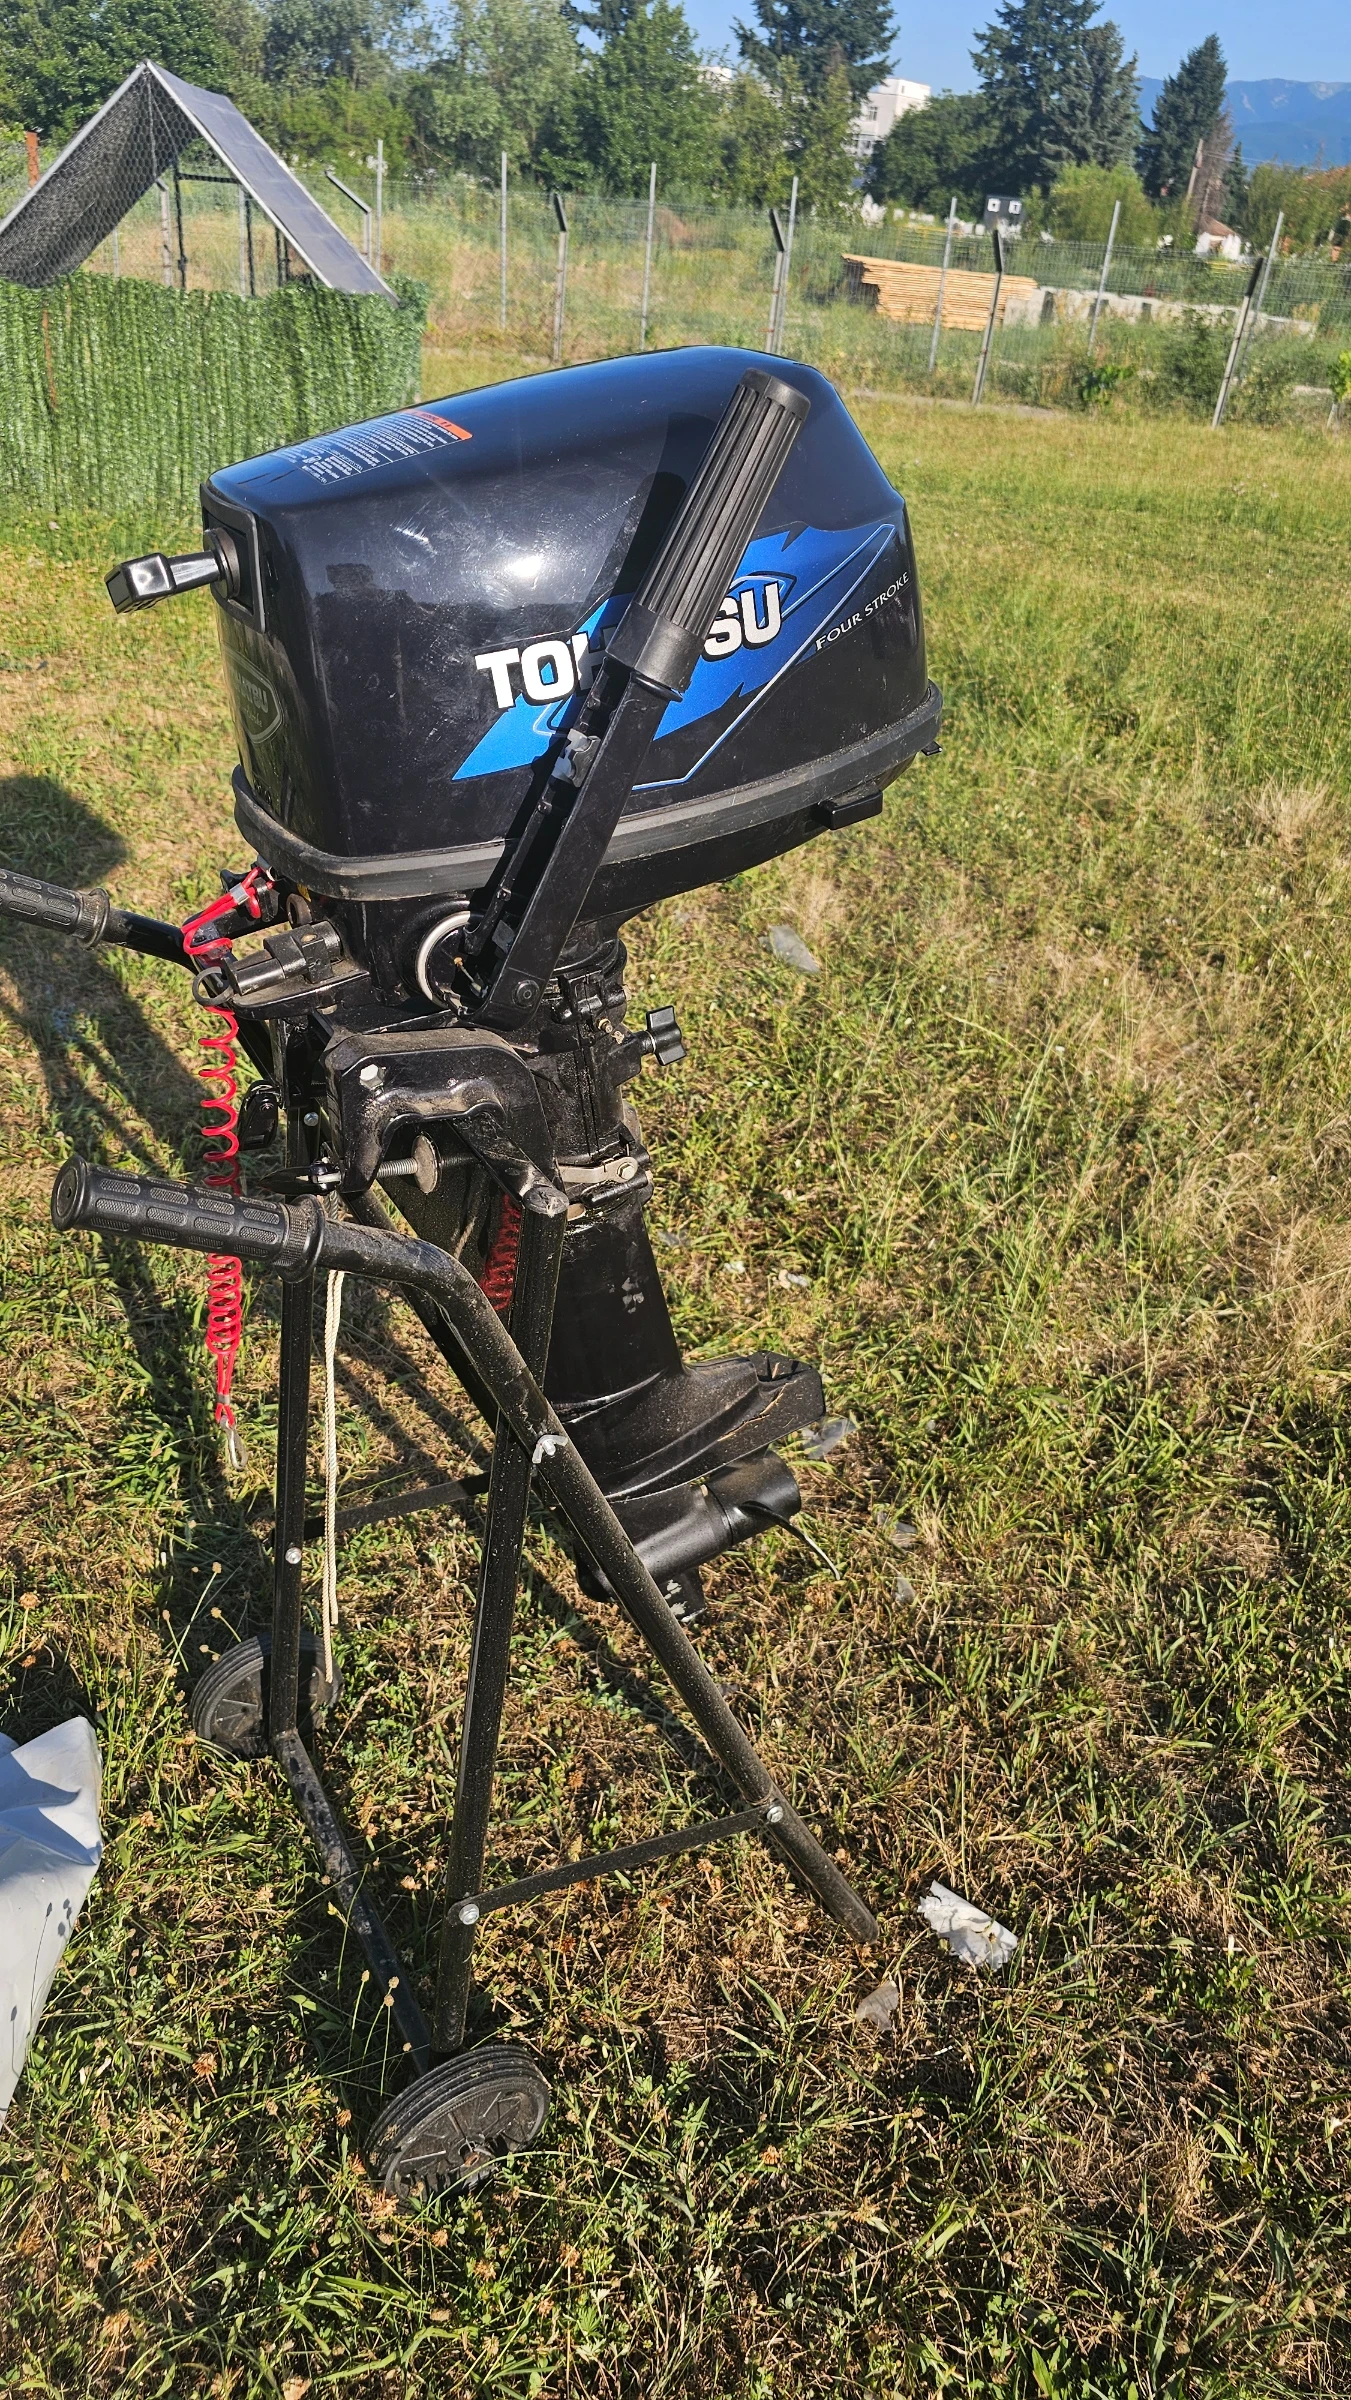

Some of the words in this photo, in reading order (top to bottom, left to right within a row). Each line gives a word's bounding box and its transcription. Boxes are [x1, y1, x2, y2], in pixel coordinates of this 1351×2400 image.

[475, 582, 782, 709] TOHSU
[815, 613, 862, 651] FOUR
[864, 572, 909, 617] STROKE
